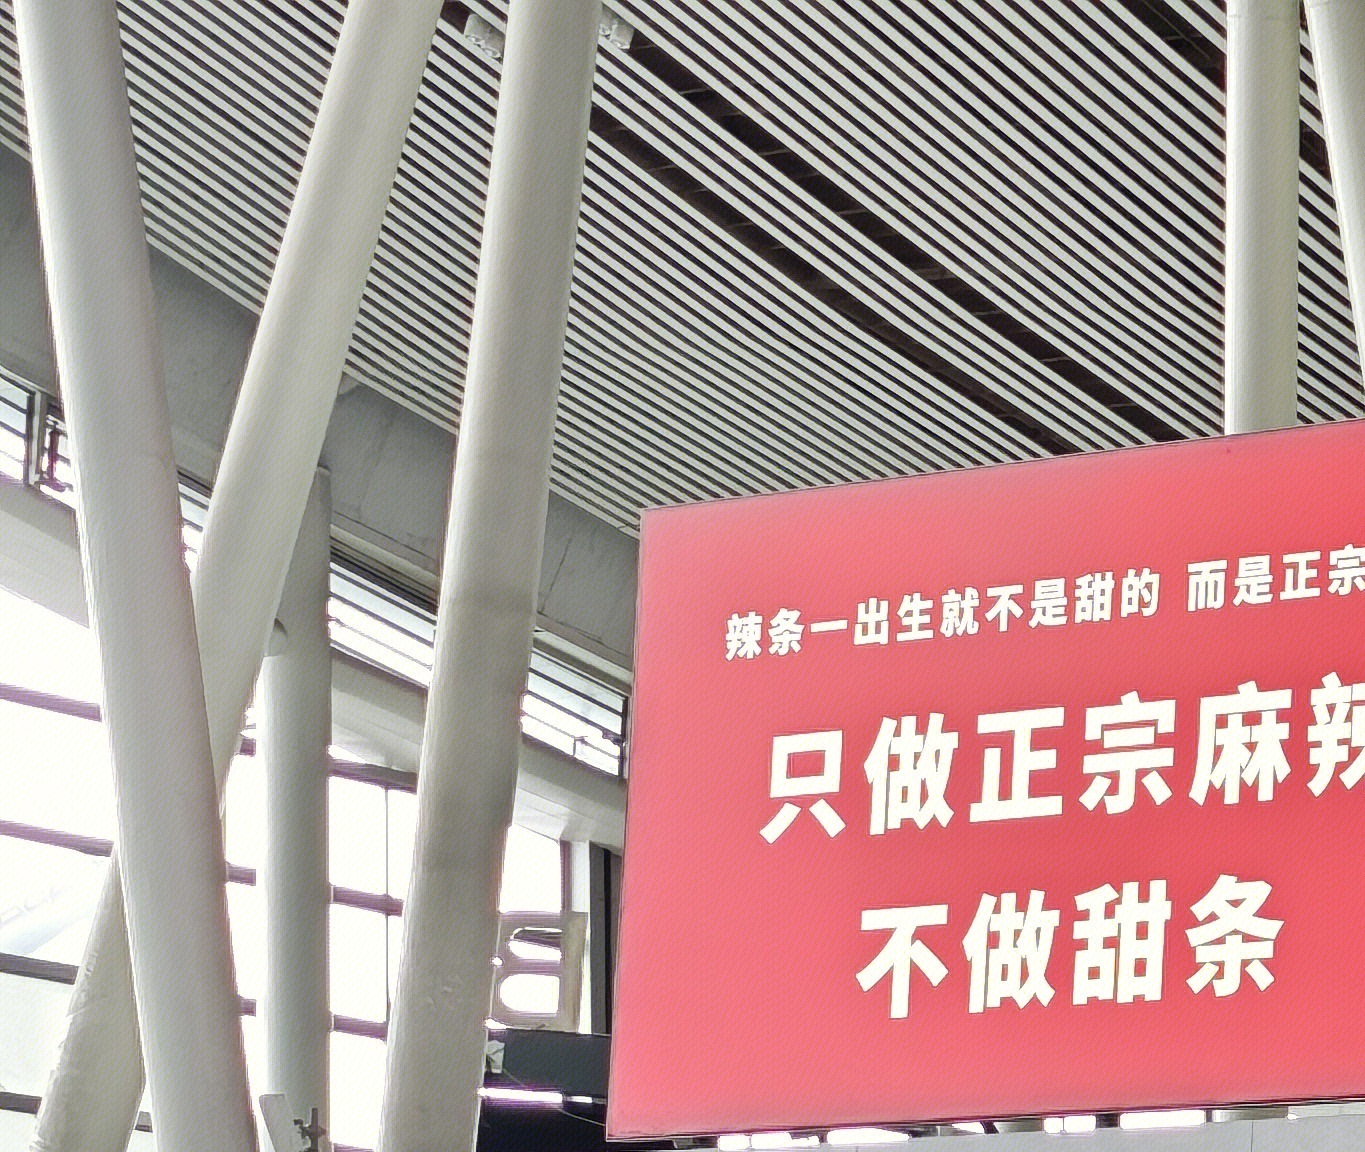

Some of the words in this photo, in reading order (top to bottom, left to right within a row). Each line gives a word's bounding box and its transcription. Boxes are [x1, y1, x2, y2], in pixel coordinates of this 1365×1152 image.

[725, 568, 1160, 661] 辣条一出生就不是甜的
[855, 873, 1285, 1020] 不做甜条
